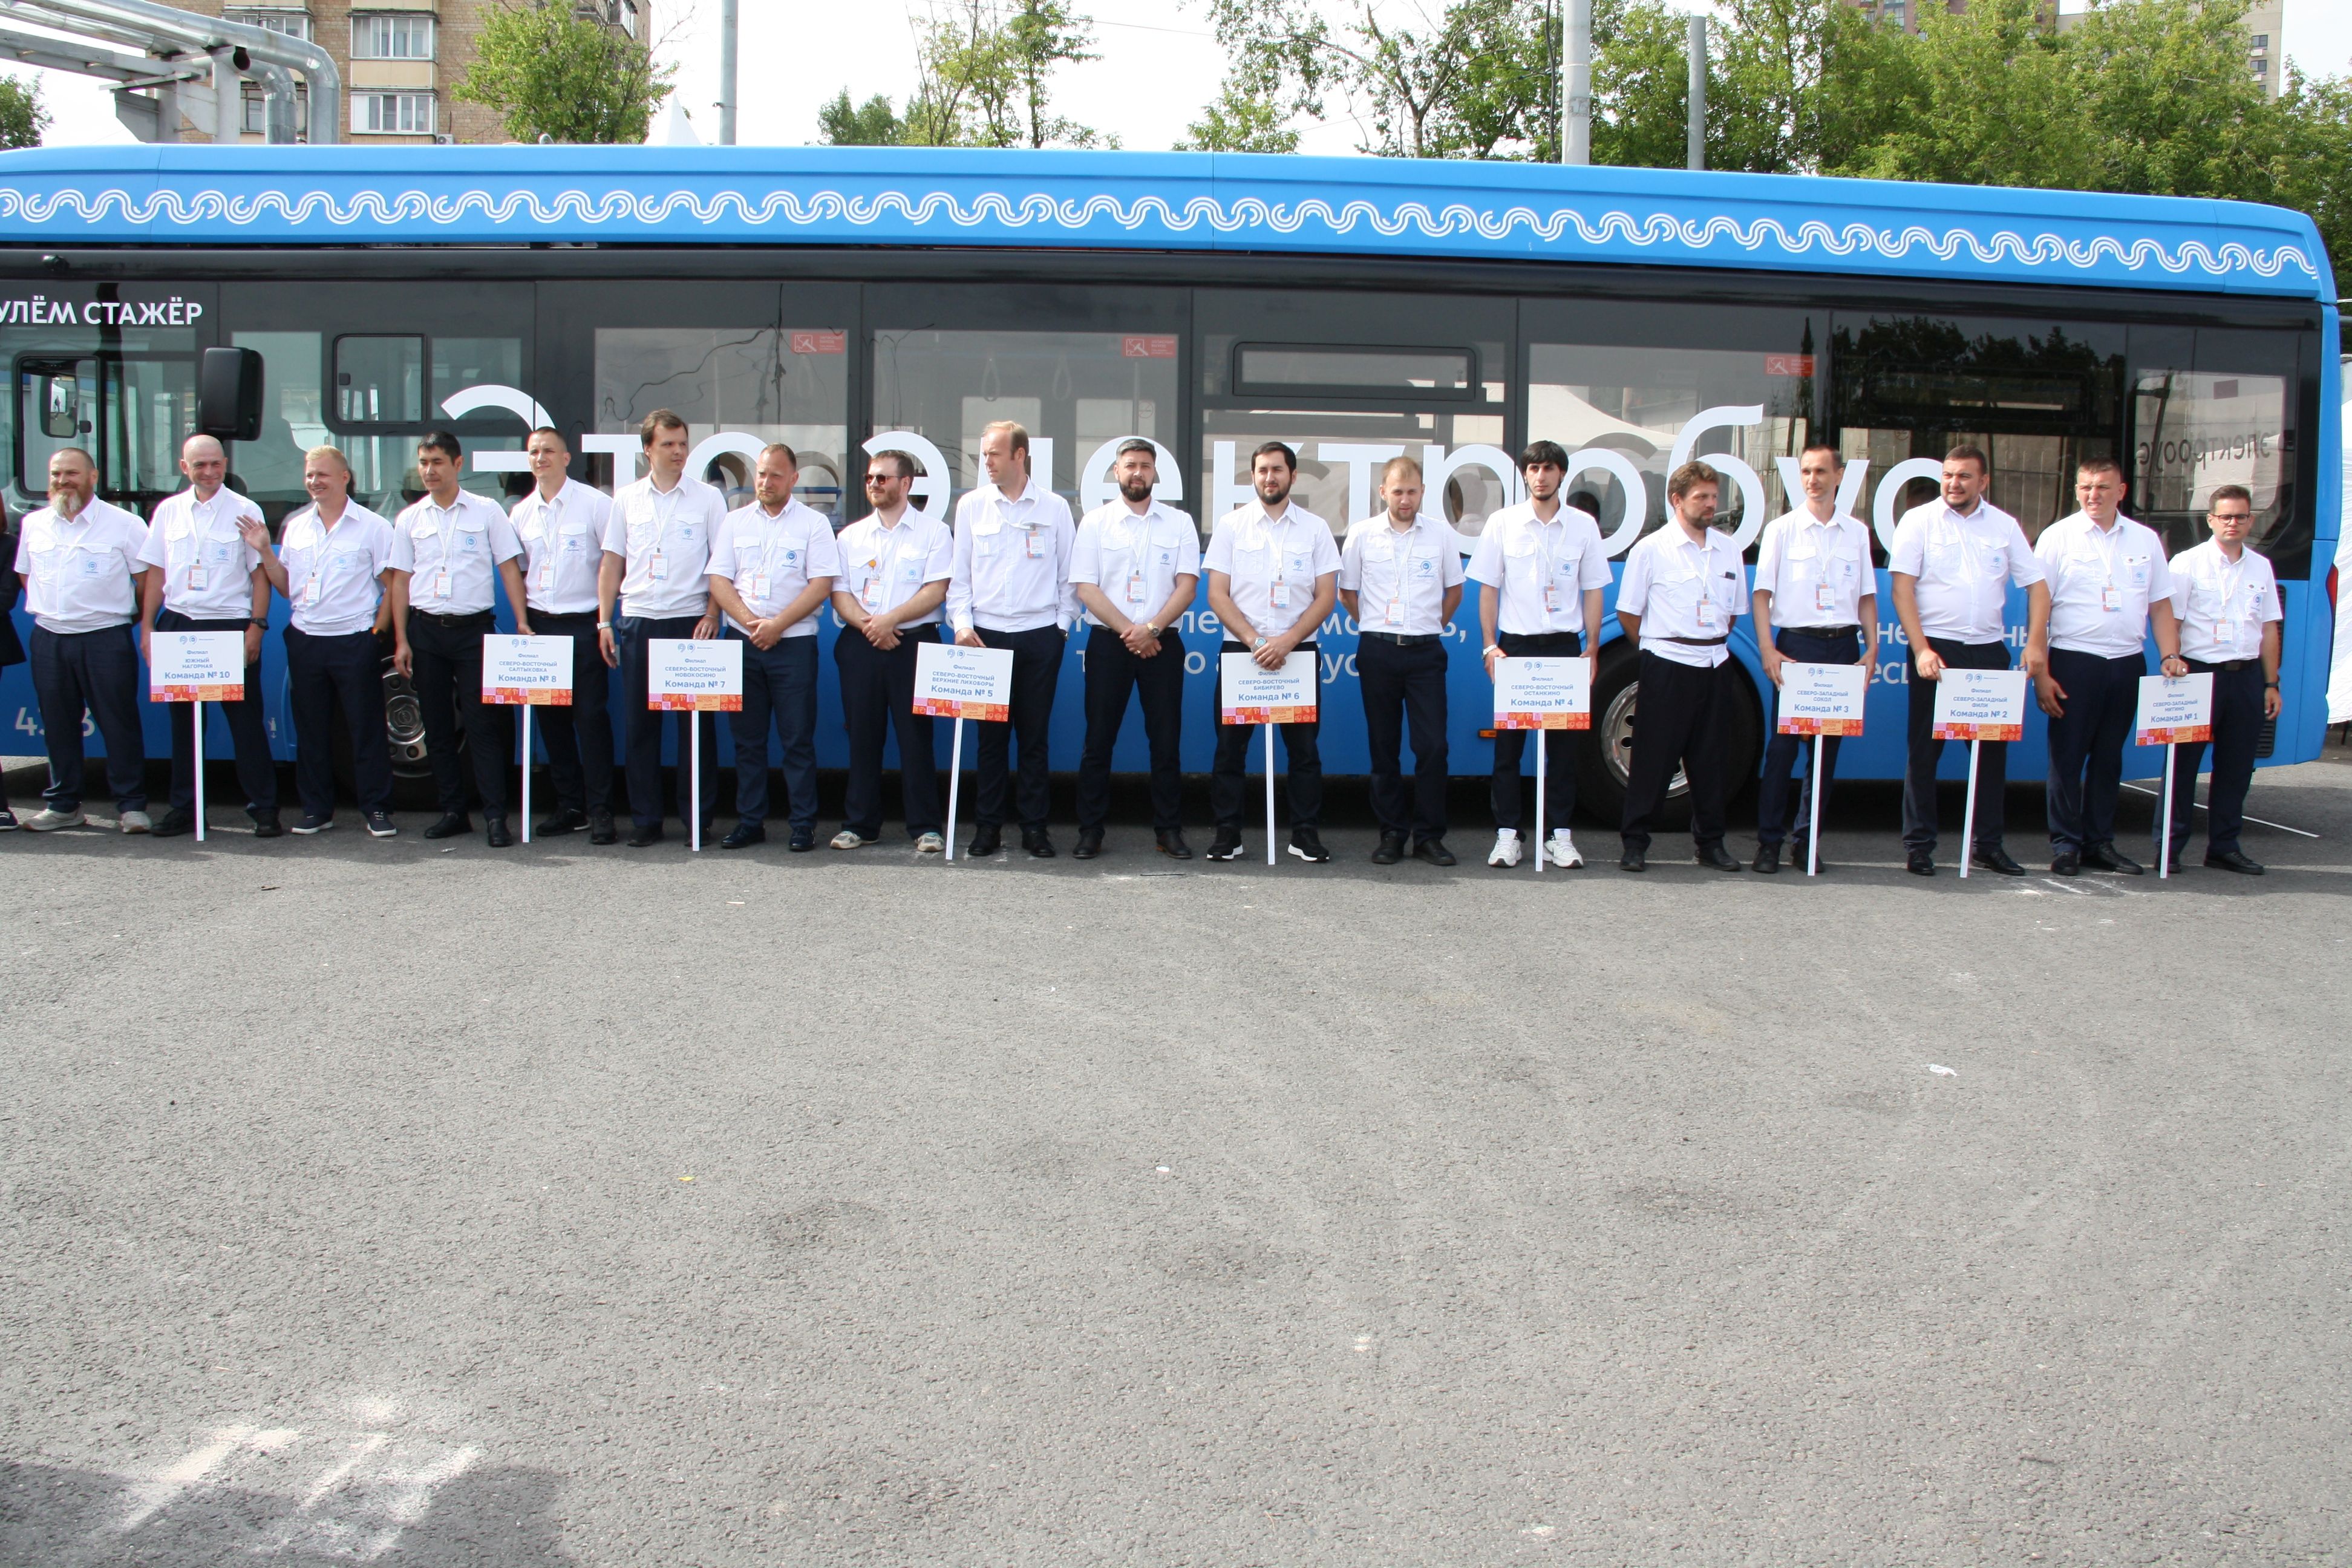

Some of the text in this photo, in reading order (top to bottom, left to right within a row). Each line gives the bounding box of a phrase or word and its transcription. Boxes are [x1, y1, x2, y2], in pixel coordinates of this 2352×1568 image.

[83, 296, 203, 325] СТАЖЁР
[933, 671, 995, 681] СЕВЕРО-ВОСТОЧНЫЙ
[932, 685, 972, 696] Команда
